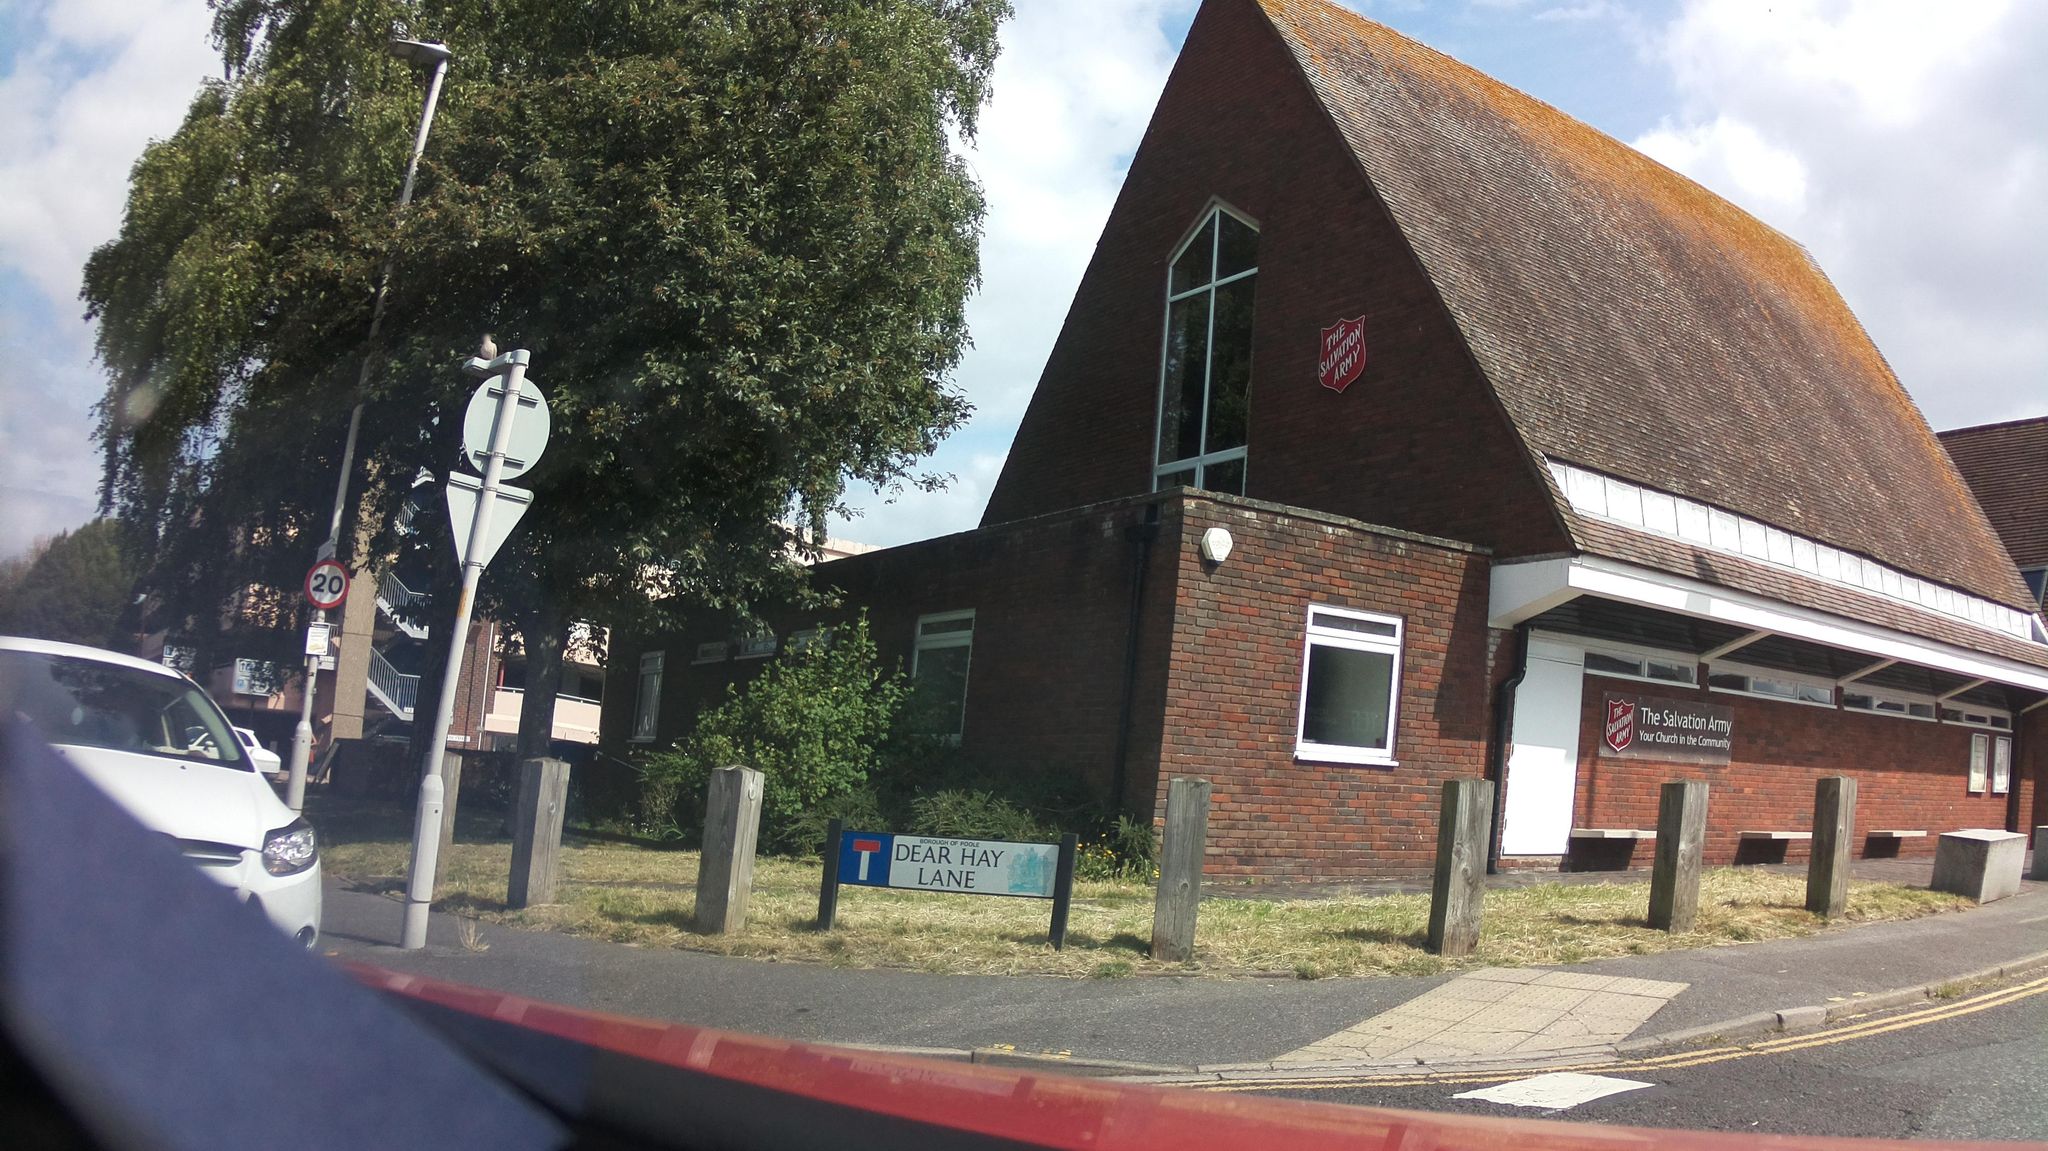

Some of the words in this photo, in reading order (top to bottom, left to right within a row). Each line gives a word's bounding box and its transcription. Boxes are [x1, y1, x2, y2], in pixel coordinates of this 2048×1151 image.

[1326, 323, 1346, 352] THE
[1320, 323, 1361, 378] SALVATION
[1333, 344, 1360, 385] ARMY
[312, 573, 344, 595] 20
[1608, 710, 1633, 737] SALVATION
[1613, 704, 1624, 720] THE
[1641, 707, 1661, 726] The
[1663, 709, 1707, 731] Salvation
[1708, 715, 1732, 737] Army
[1614, 724, 1631, 745] ARMY
[1639, 729, 1655, 742] Your
[1656, 732, 1678, 744] Church
[1679, 734, 1686, 745] in
[1687, 734, 1697, 746] the
[1698, 736, 1731, 751] Community
[895, 843, 952, 865] DEAR
[960, 847, 1005, 868] HAY
[918, 867, 976, 889] LANE
